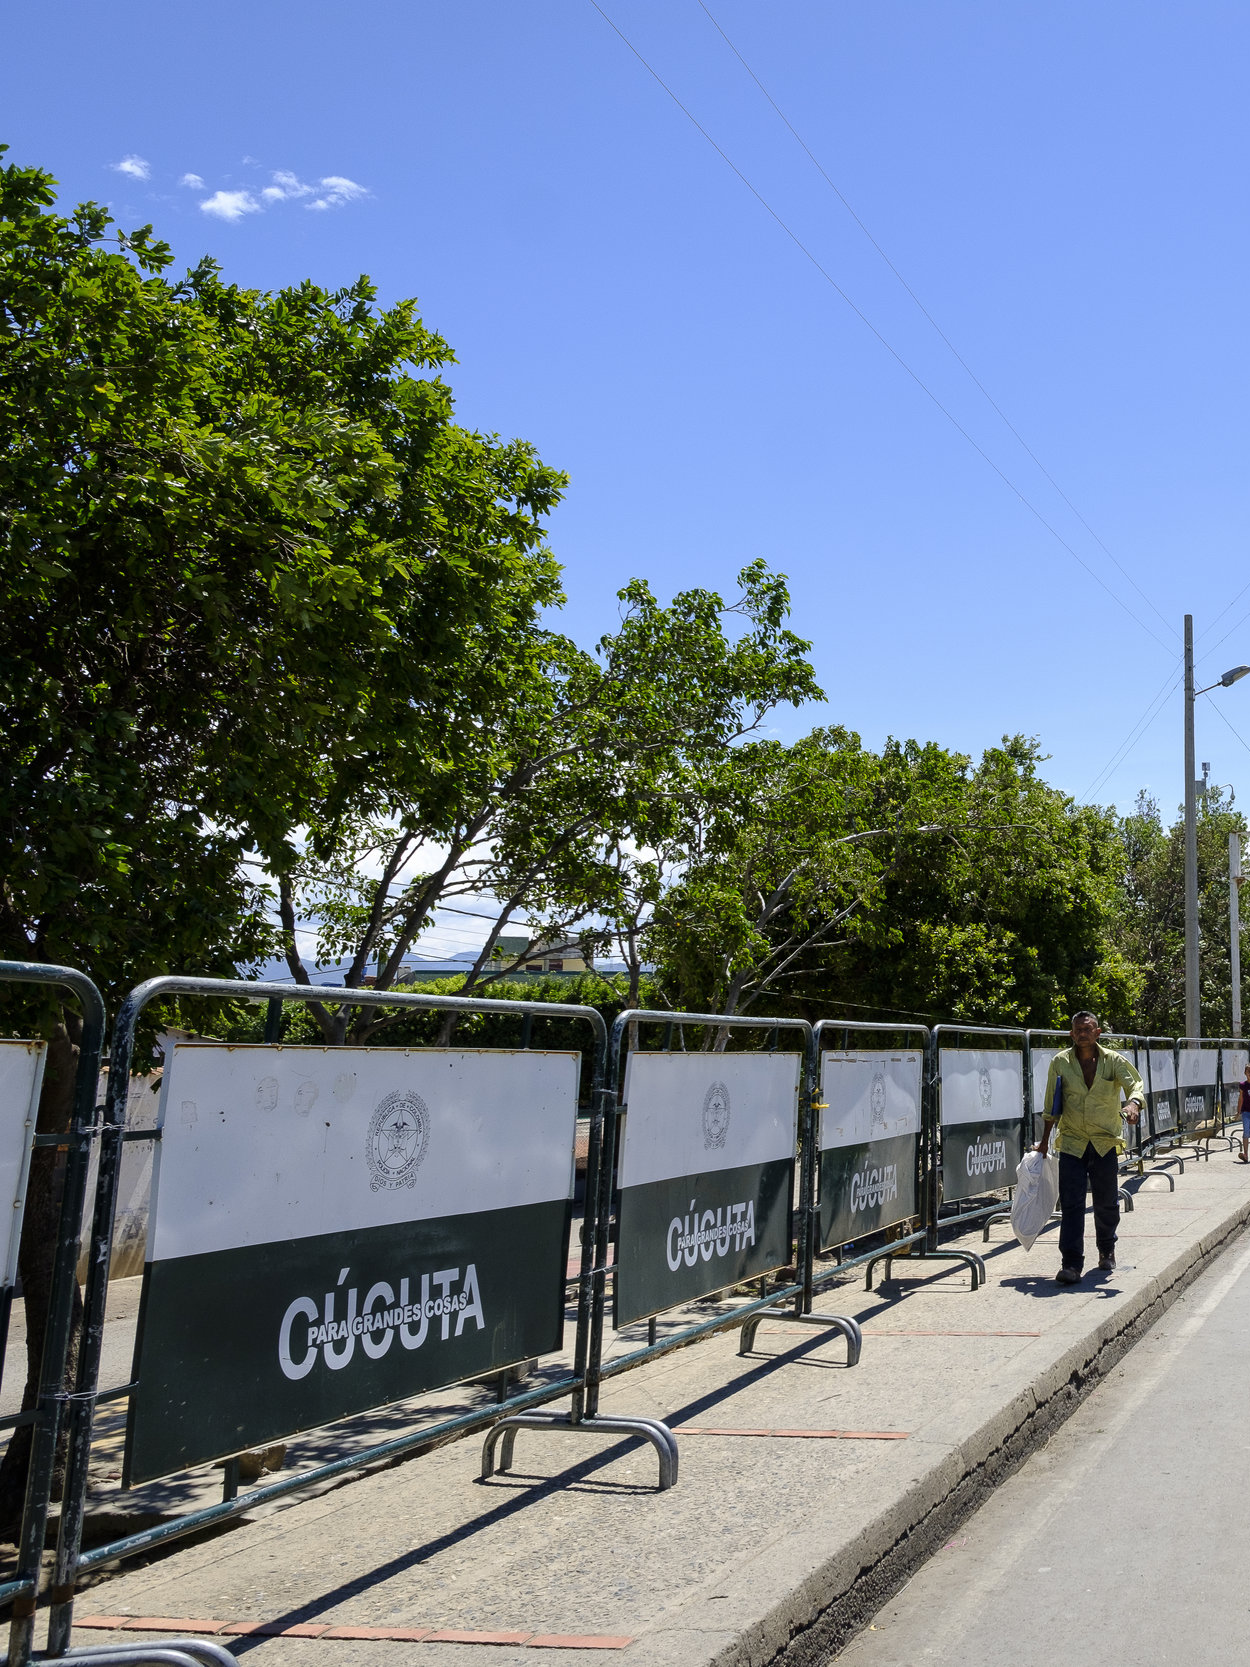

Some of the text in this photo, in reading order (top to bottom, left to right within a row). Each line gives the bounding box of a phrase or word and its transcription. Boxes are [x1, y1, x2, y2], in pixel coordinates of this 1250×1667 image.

[374, 1175, 386, 1187] DIOS
[395, 1173, 414, 1187] PATRIA
[966, 1135, 1006, 1176] CÚCUTA
[850, 1160, 897, 1213] CÚCUTA
[666, 1199, 755, 1271] CÚCUTA
[677, 1219, 749, 1250] PARA GRANDES COSAS
[278, 1263, 485, 1380] CÚCUTA
[307, 1291, 468, 1346] PARA GRANDES COSAS
